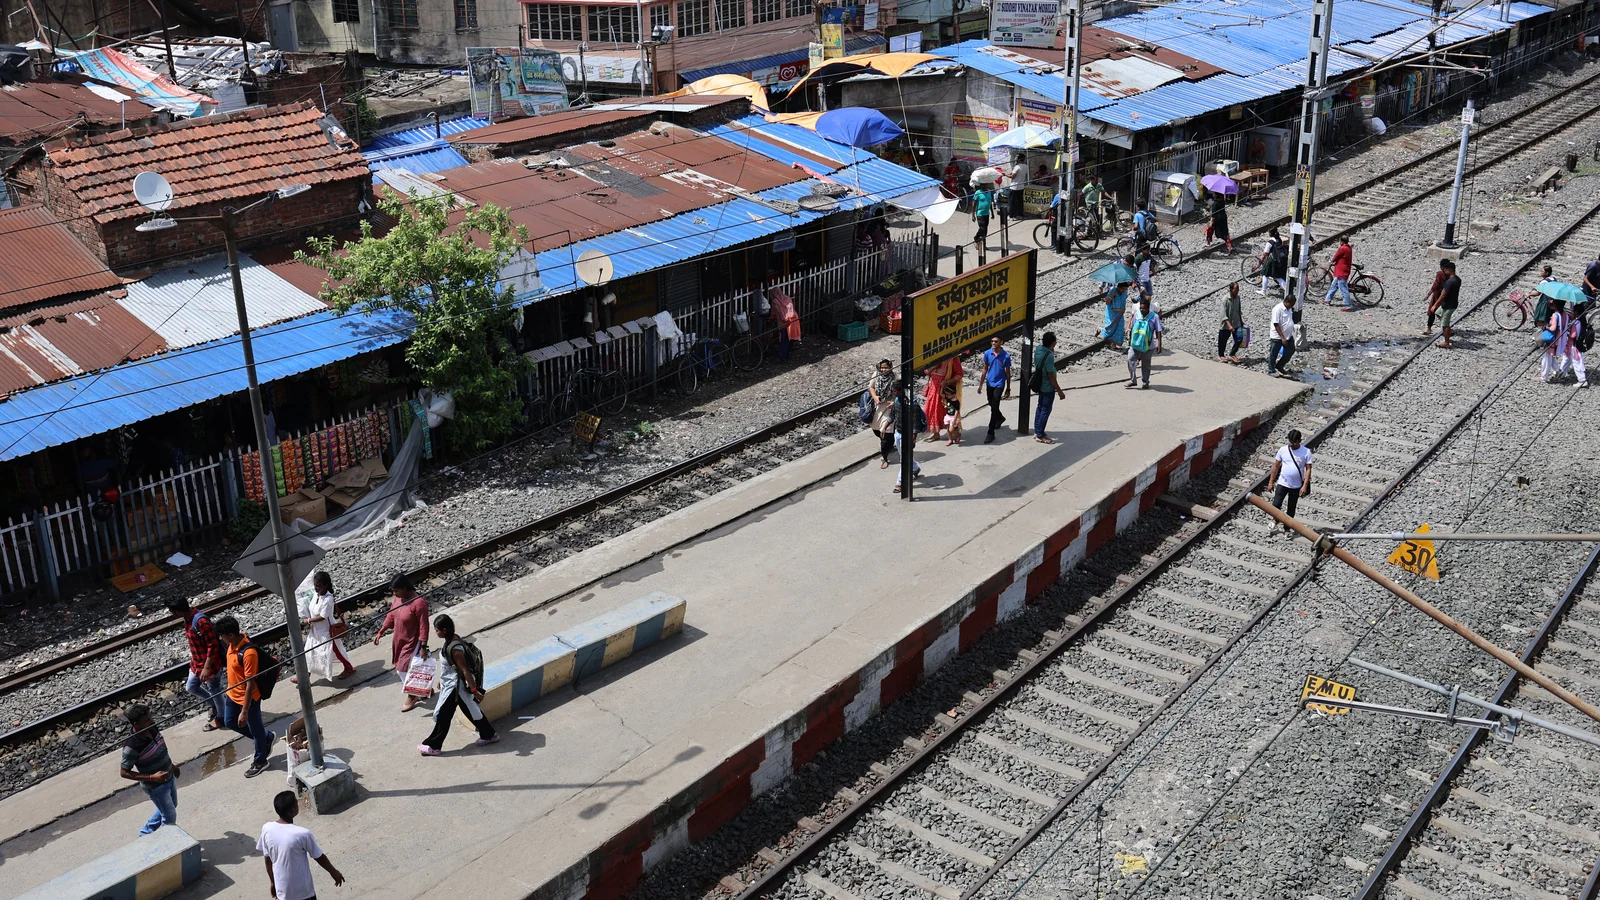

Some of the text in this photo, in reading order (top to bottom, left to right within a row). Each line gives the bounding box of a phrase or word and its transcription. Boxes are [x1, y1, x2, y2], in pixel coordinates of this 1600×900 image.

[936, 266, 1010, 312] মধ্যমগ্রাম
[936, 287, 1009, 332] मध्यमग्राम
[922, 307, 1012, 360] MADHYAMGRAM
[575, 423, 594, 435] STOP
[1400, 541, 1431, 573] 30
